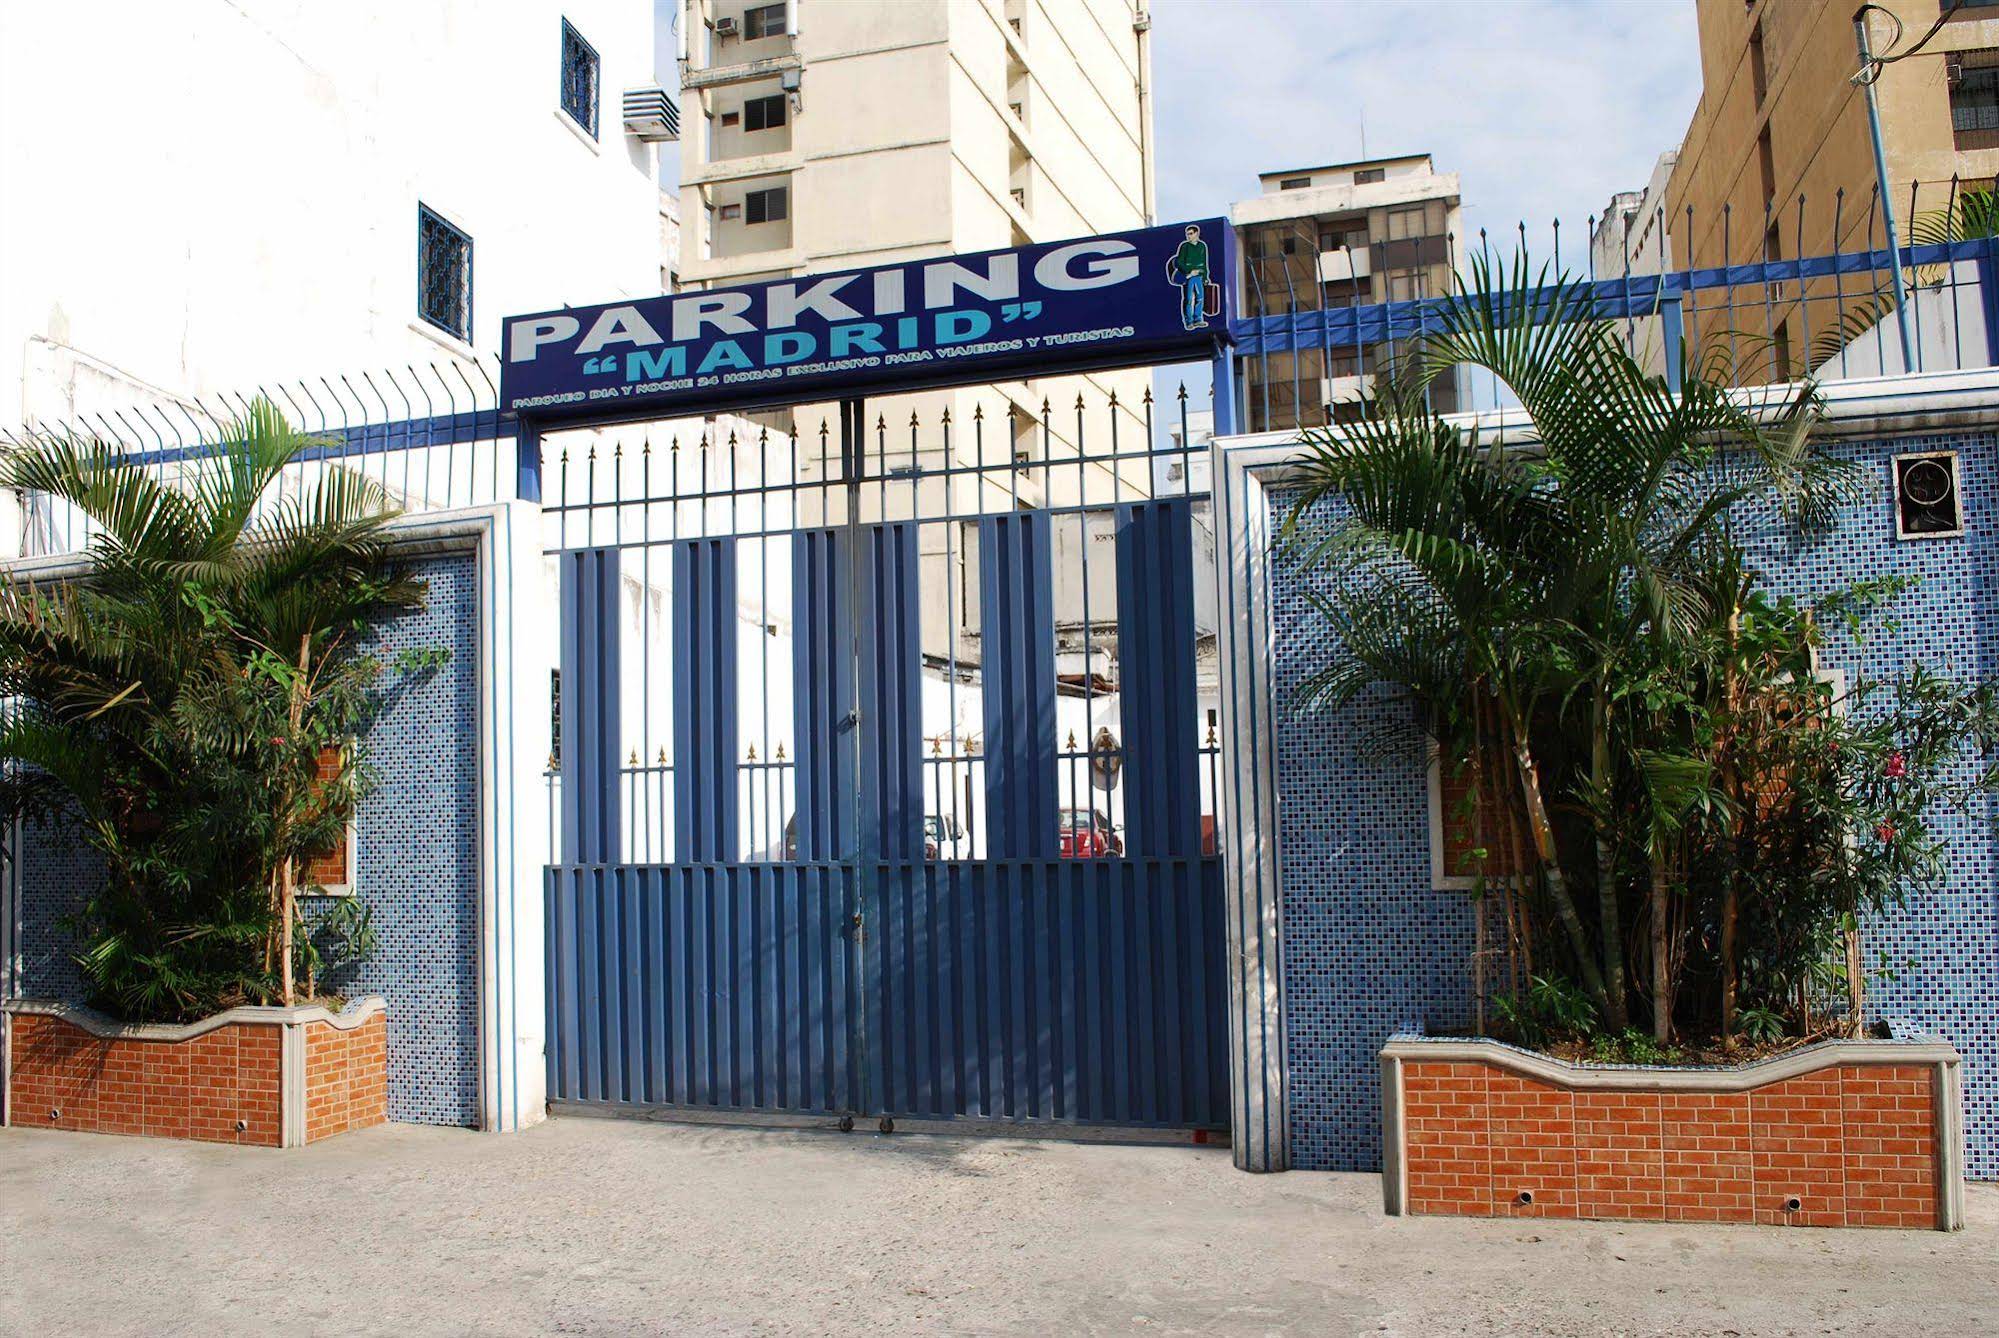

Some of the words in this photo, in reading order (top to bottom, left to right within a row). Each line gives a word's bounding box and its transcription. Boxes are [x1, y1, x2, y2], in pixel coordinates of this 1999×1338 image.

[510, 240, 1140, 363] PARKING
[512, 390, 585, 409] PARQUEO
[590, 387, 619, 400] DIA
[621, 386, 632, 396] Y
[636, 378, 693, 394] NOCHE
[697, 375, 719, 387] 24
[724, 367, 782, 383] HORAS
[787, 356, 880, 376] EXCLUSIVO
[885, 350, 931, 364] PARA
[936, 338, 1022, 358] VIAJEROS
[1028, 336, 1041, 347] Y
[1043, 326, 1135, 345] TURISTAS
